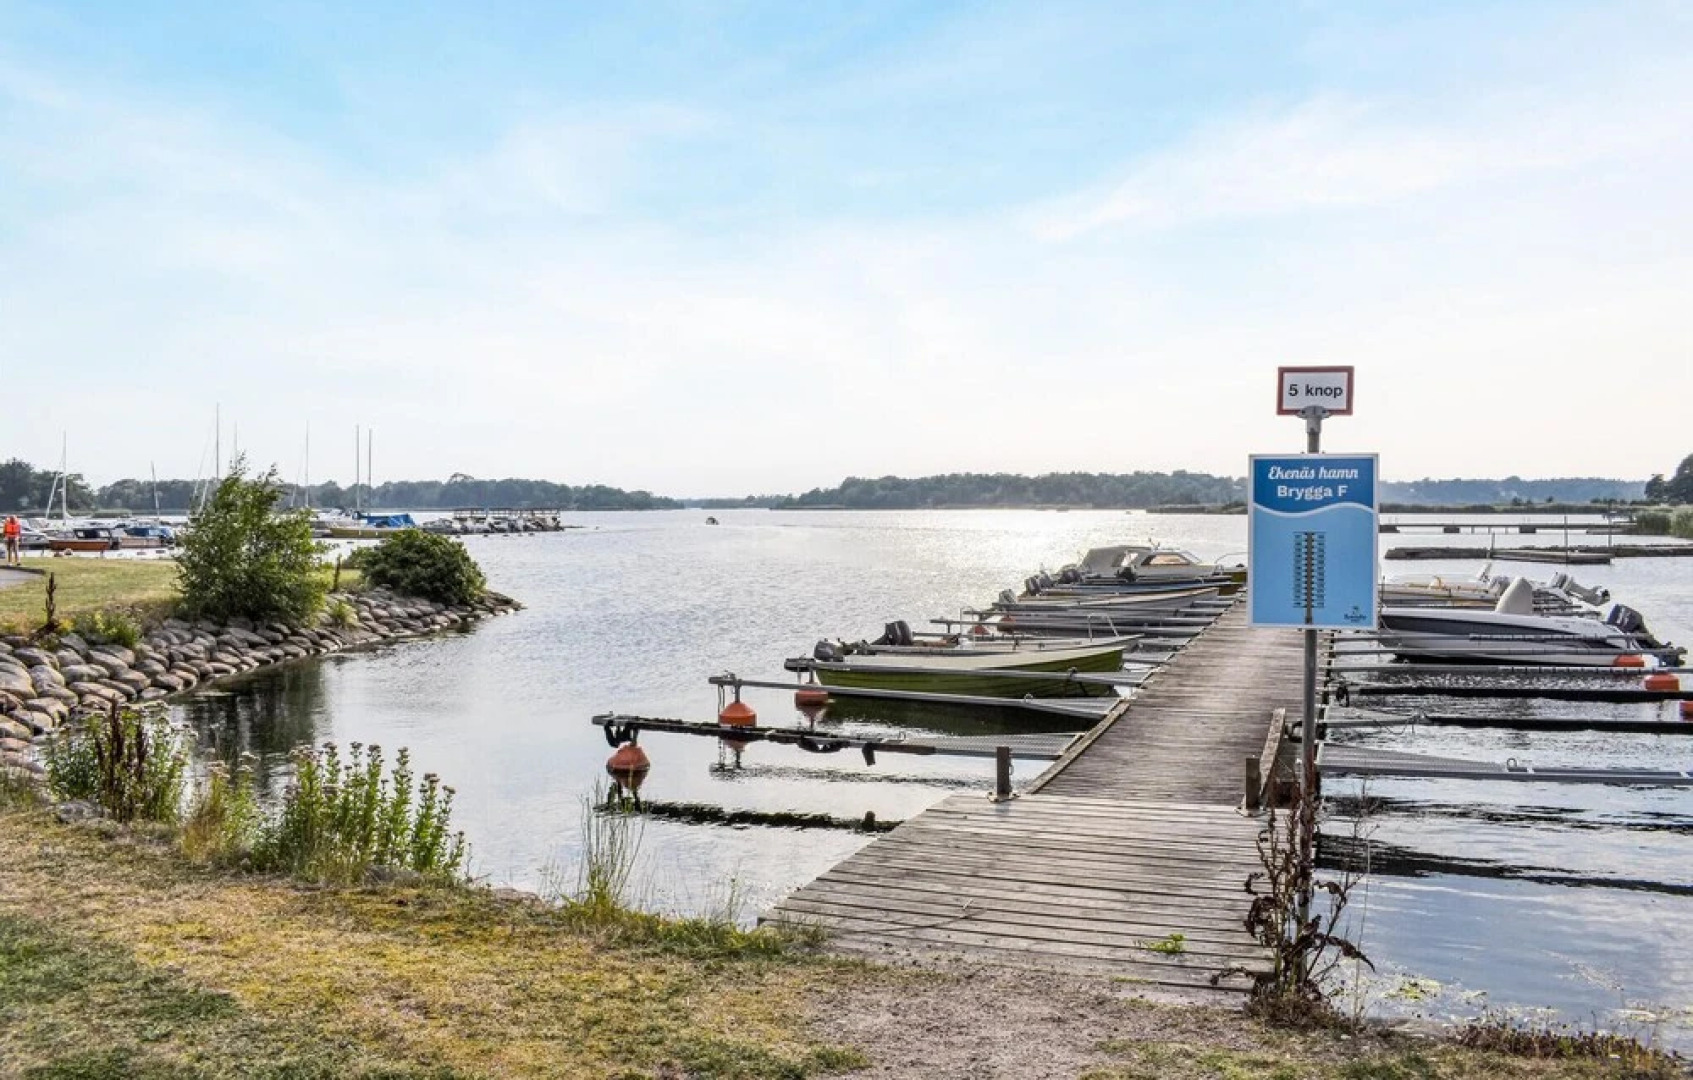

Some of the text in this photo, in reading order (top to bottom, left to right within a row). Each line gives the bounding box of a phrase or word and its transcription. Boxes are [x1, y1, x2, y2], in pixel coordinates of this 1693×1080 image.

[1288, 383, 1344, 399] 5 knop
[1267, 466, 1359, 480] Ekenäs hamn
[1277, 485, 1349, 501] Brygga F
